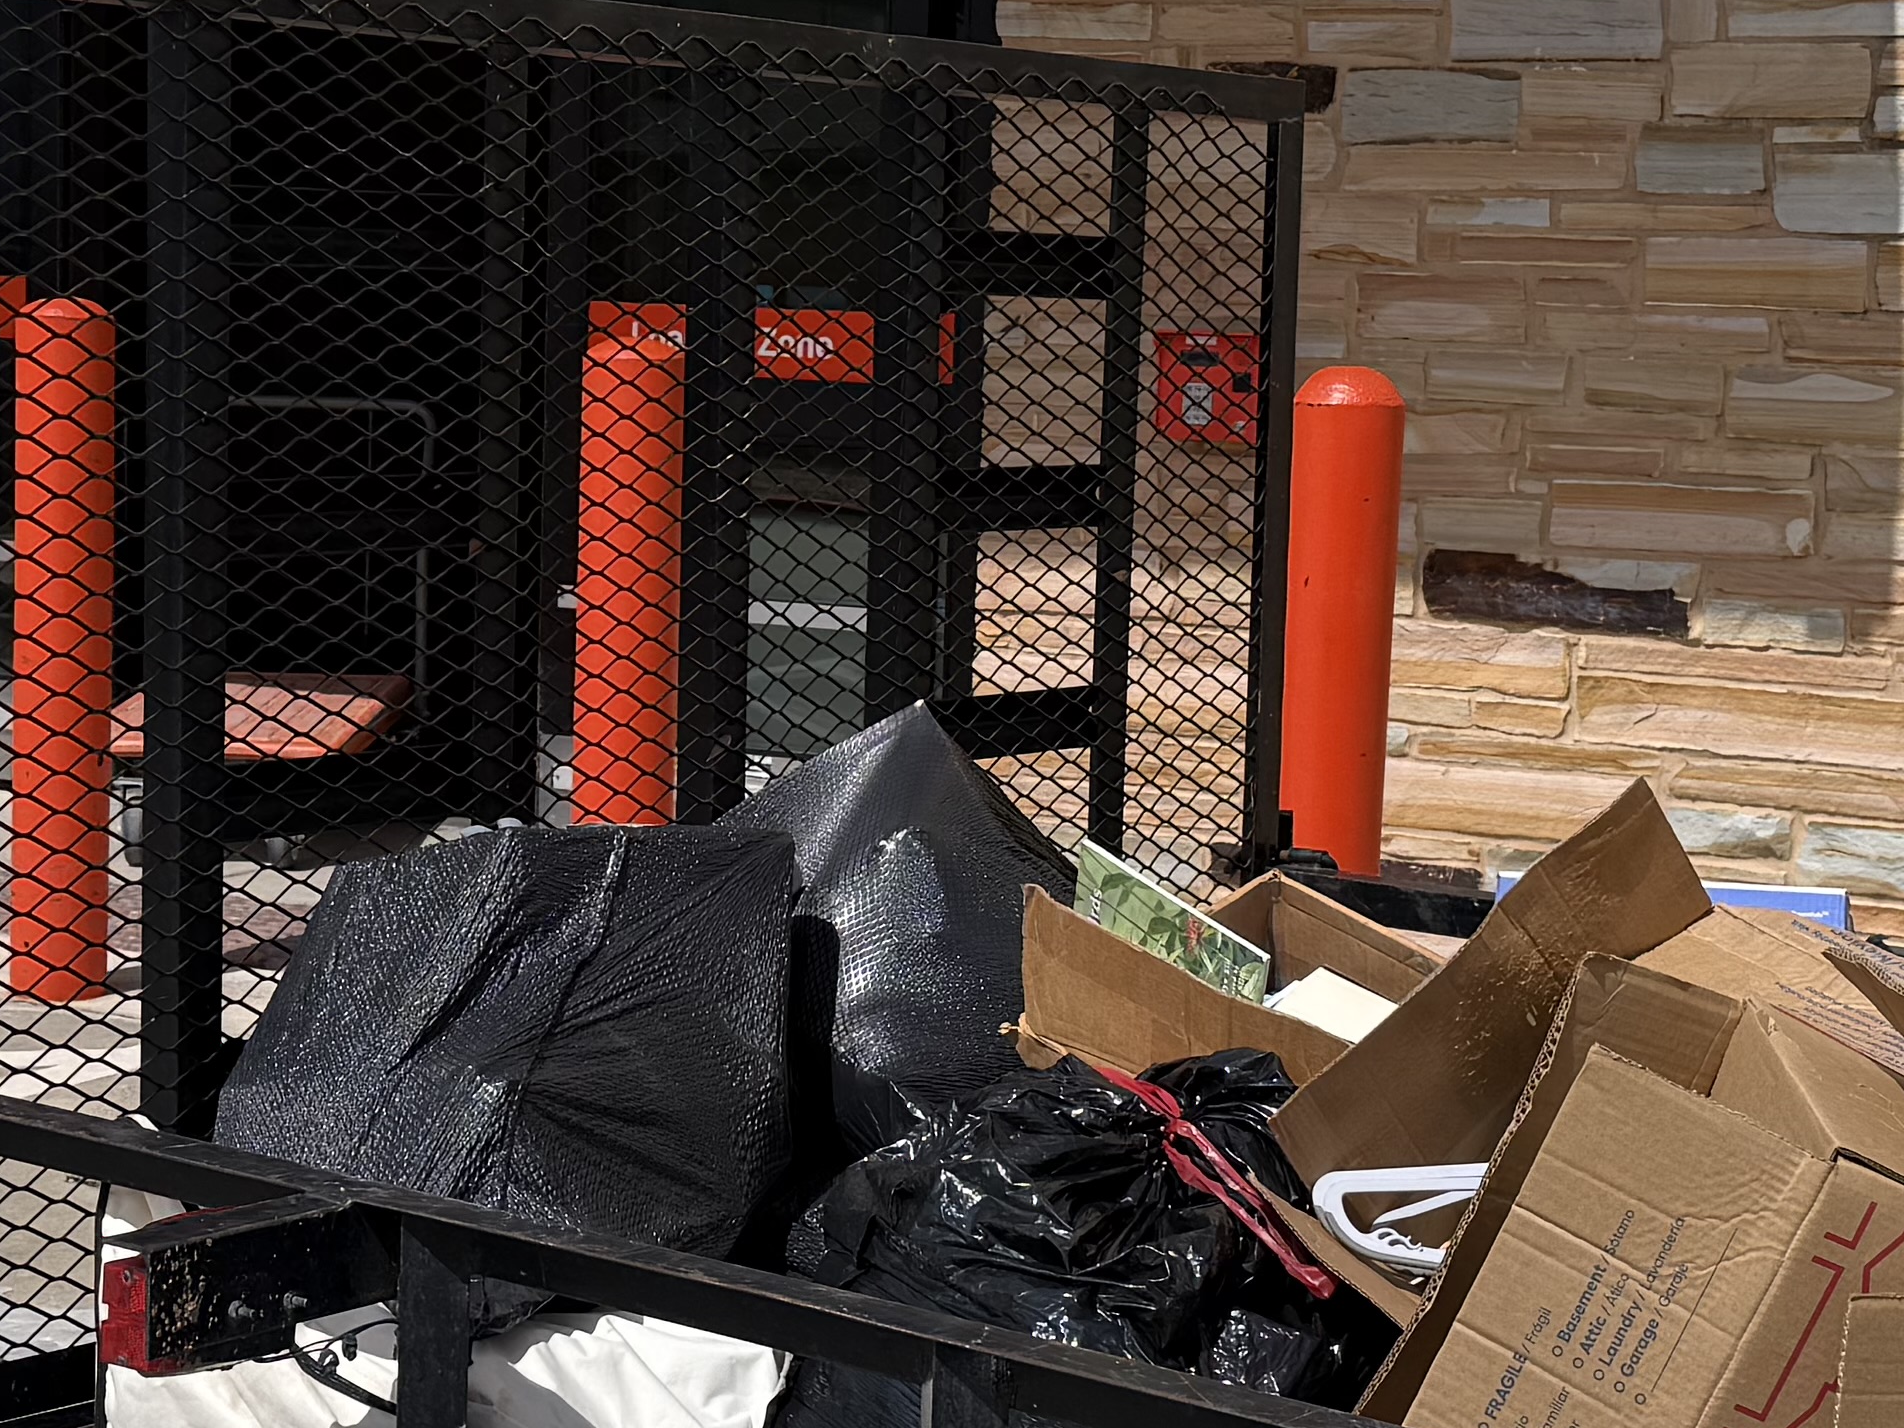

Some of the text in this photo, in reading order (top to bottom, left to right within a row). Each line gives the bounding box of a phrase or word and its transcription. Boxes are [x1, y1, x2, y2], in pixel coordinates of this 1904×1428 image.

[756, 326, 835, 360] Zone
[1556, 1264, 1607, 1343] Basement
[1579, 1316, 1607, 1355] Attic
[1599, 1301, 1643, 1367] Laundry
[1642, 1216, 1686, 1291] Lavandería
[1620, 1318, 1659, 1378] Garage
[1659, 1263, 1689, 1308] Garaje
[1485, 1351, 1528, 1420] FRAGILE
[1525, 1307, 1552, 1345] Frágil
